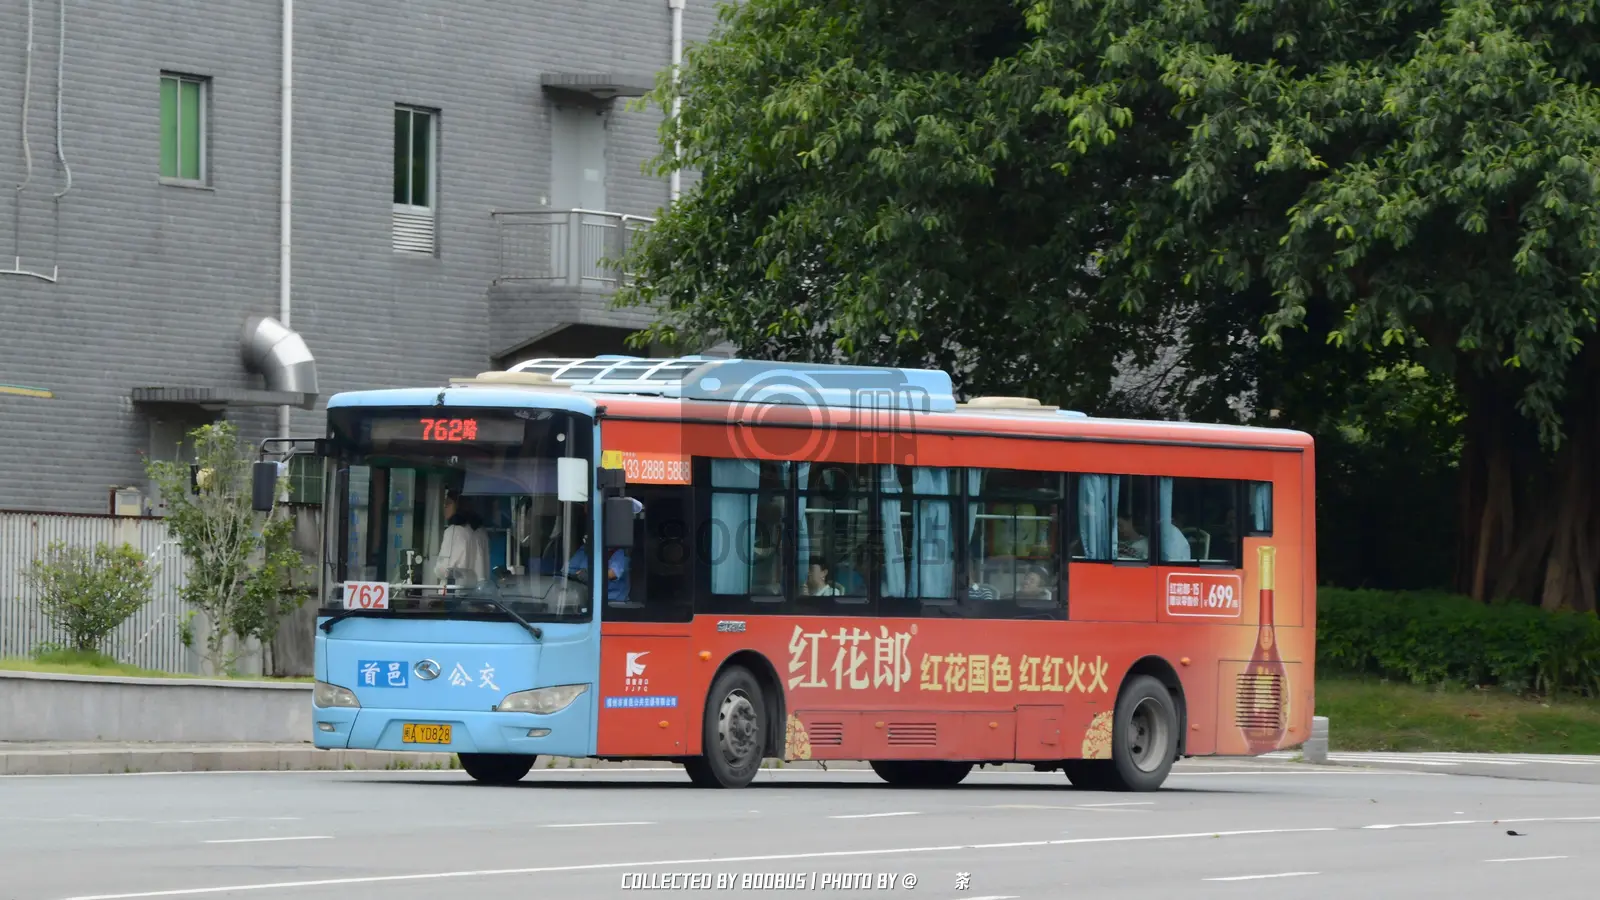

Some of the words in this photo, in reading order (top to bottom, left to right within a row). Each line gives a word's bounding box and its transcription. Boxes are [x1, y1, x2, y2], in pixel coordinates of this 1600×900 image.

[420, 418, 477, 441] 762路
[641, 460, 665, 480] 2888
[667, 461, 690, 481] 5888
[347, 584, 385, 609] 762
[788, 625, 912, 692] 红花郎
[360, 662, 406, 687] 首邑
[448, 661, 500, 691] 公交
[920, 653, 1013, 693] 红花国色
[1019, 655, 1109, 693] 红红火火
